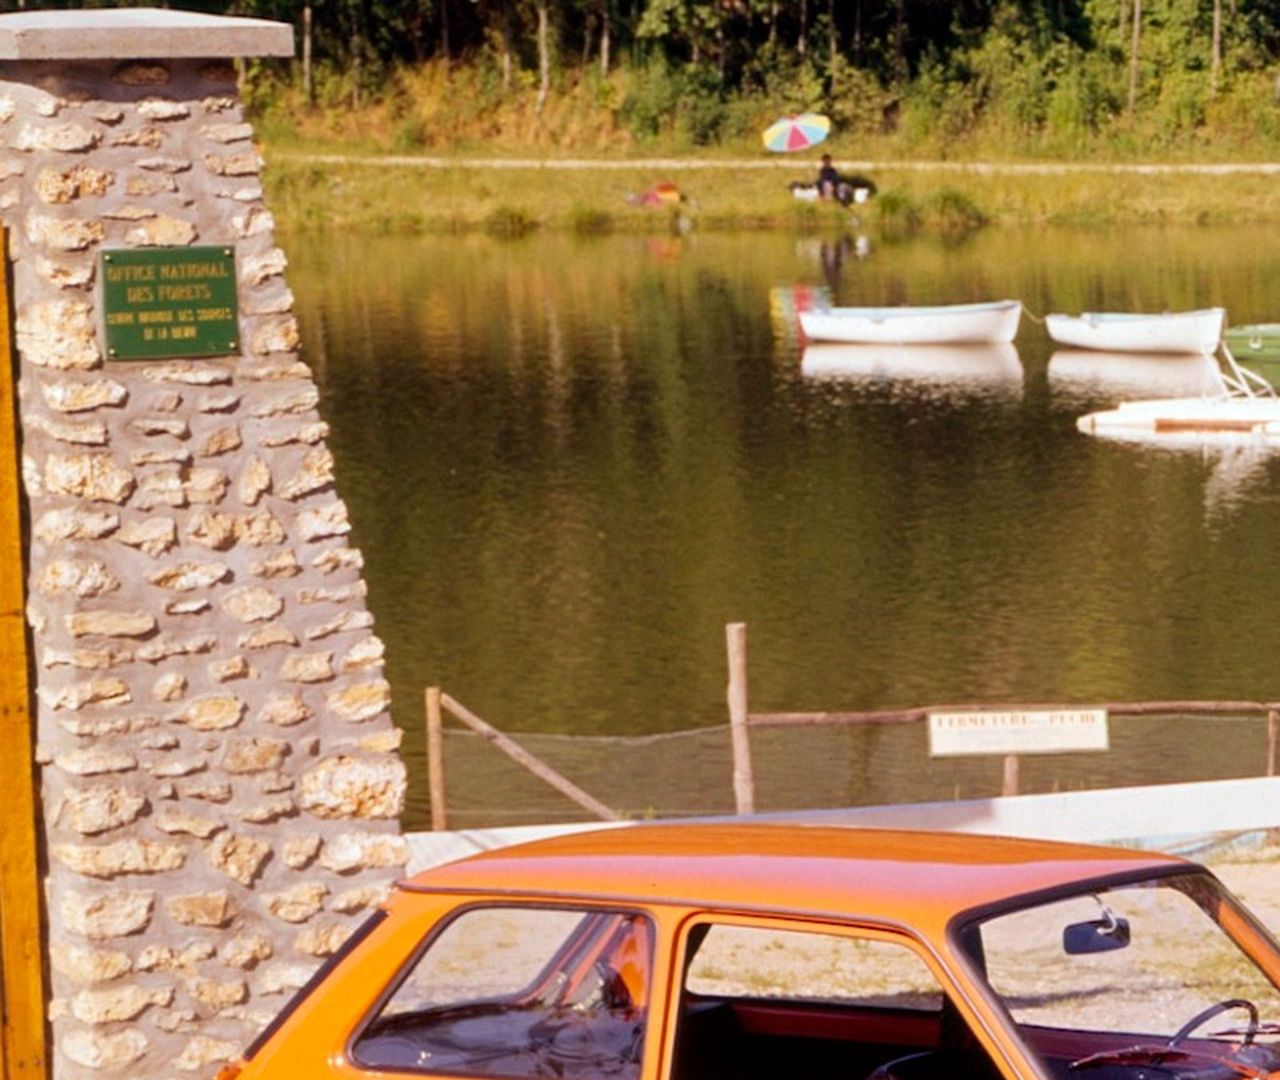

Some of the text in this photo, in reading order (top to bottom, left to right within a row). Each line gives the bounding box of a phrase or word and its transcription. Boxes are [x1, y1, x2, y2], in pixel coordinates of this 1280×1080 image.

[107, 261, 229, 281] OFFICE NATIONAL
[127, 286, 154, 302] DES
